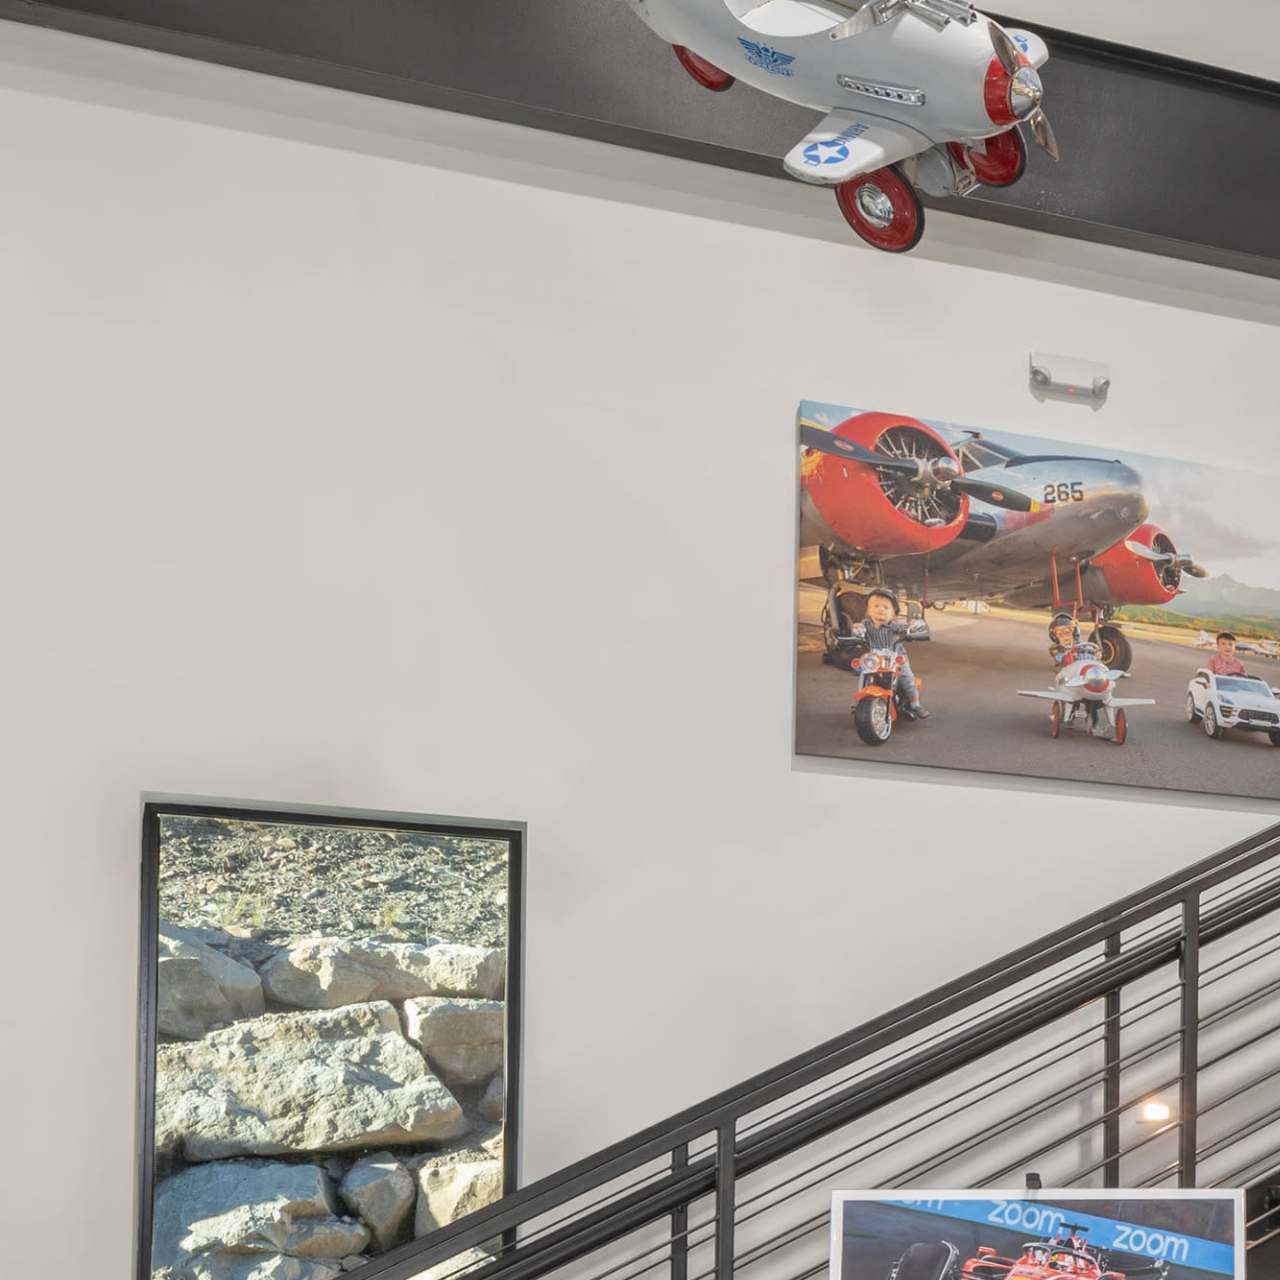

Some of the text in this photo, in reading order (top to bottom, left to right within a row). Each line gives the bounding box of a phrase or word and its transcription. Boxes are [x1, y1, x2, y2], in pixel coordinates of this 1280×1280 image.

[1043, 481, 1084, 503] 265
[987, 1200, 1065, 1232] zoom
[1112, 1224, 1189, 1262] zoom
